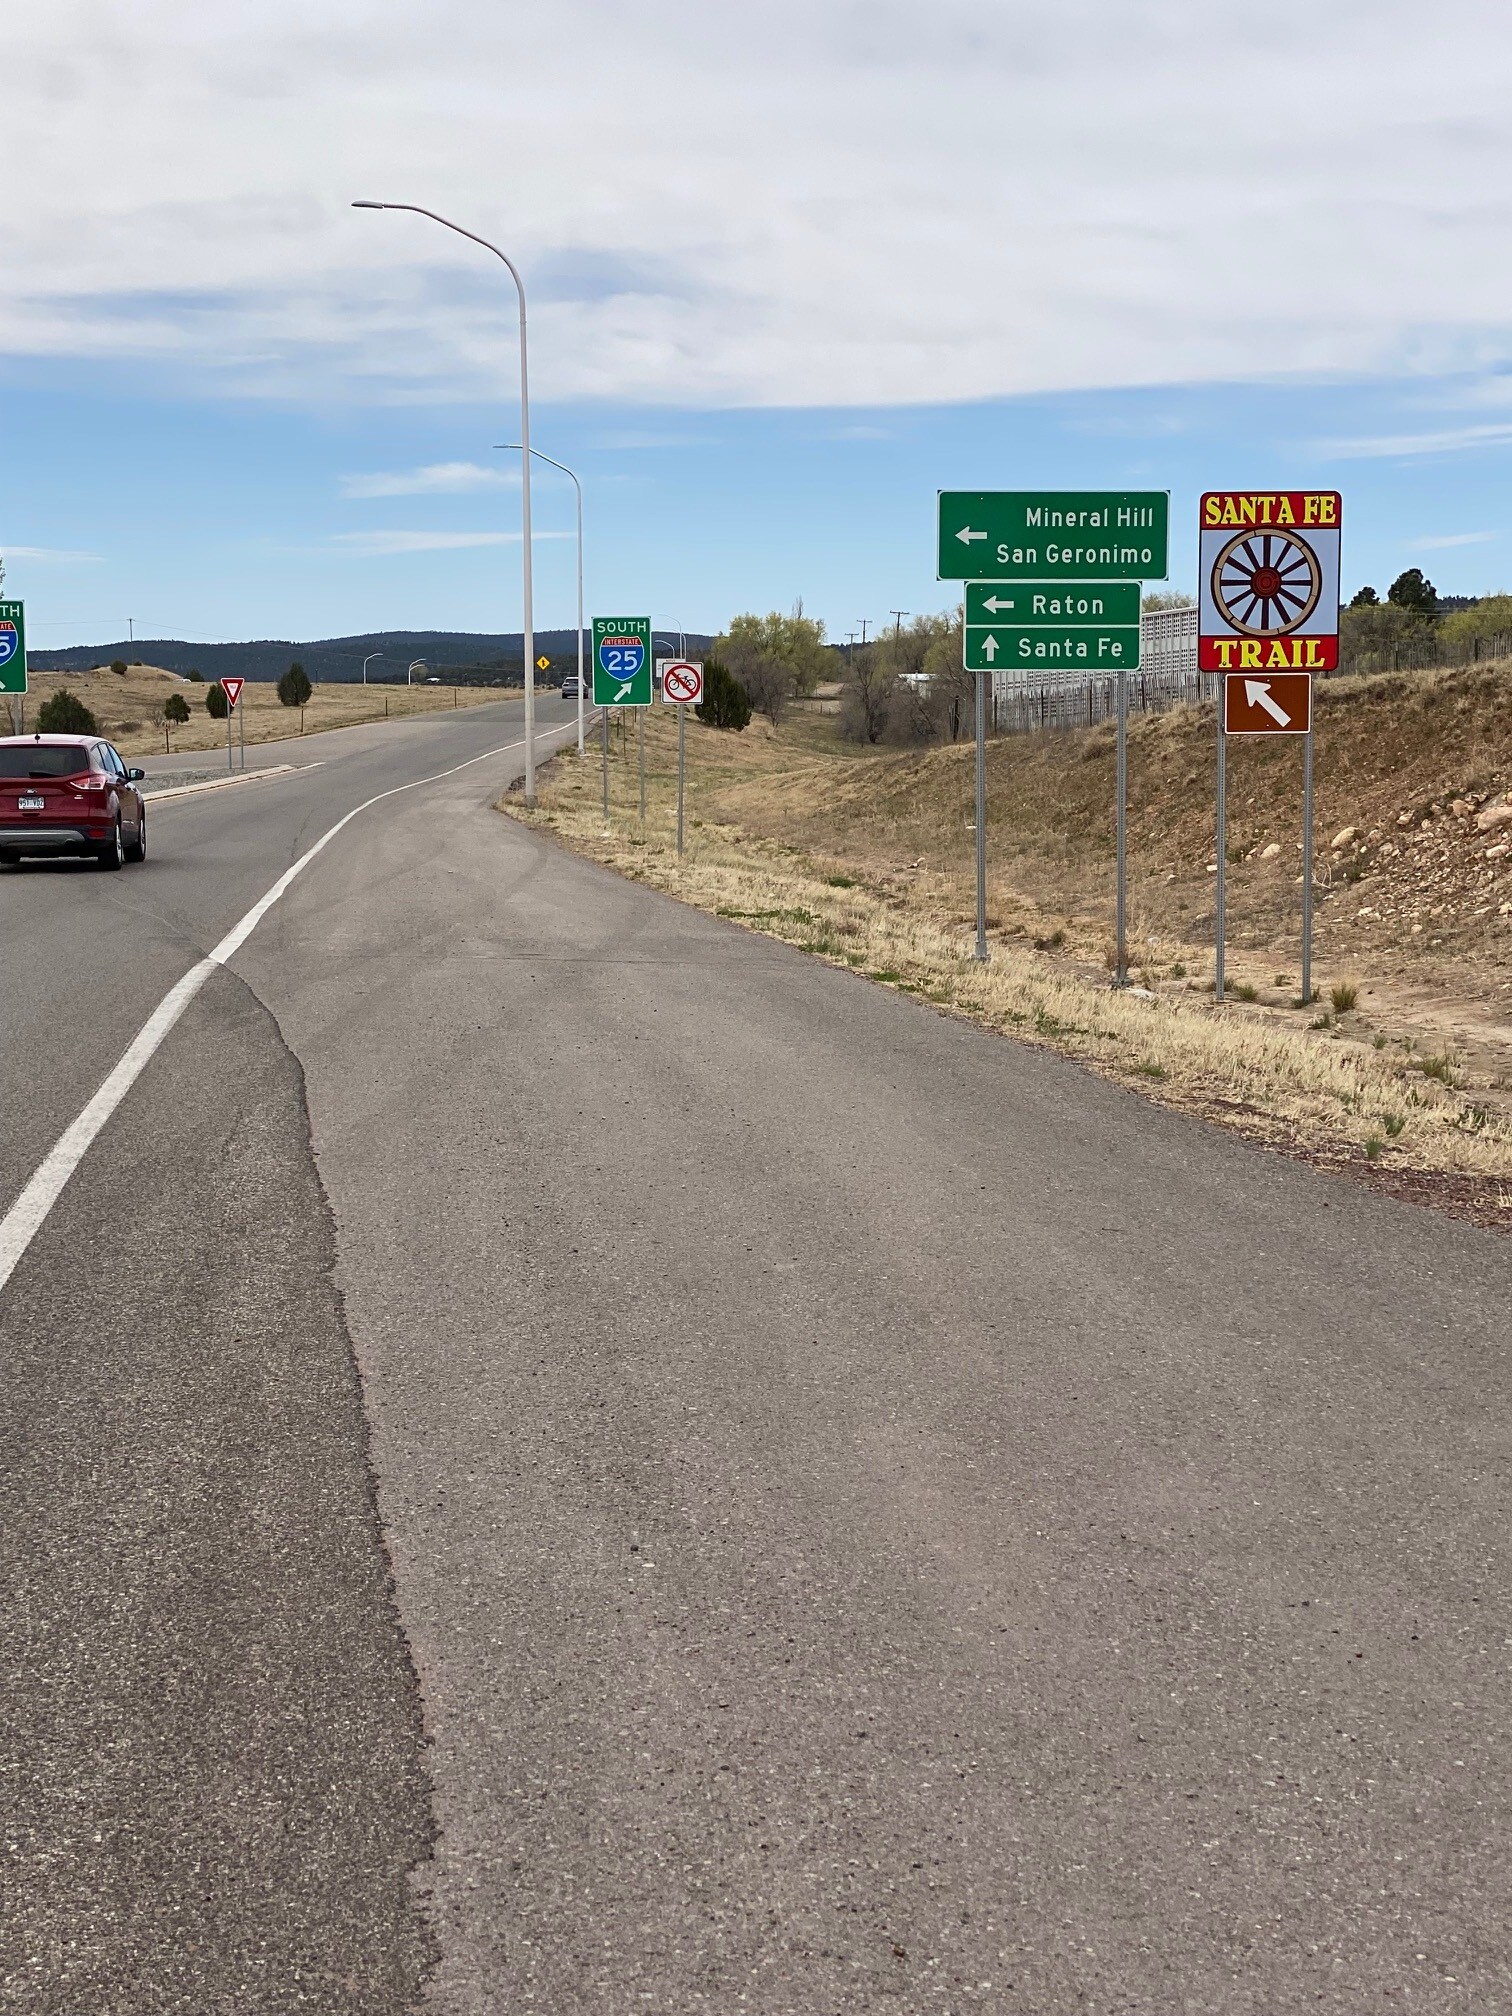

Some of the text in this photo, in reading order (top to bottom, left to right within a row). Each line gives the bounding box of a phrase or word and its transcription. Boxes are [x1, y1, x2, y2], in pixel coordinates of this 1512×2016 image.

[1026, 507, 1153, 527] Mineral Hill
[1205, 496, 1336, 524] SANTA FE
[997, 544, 1152, 563] San Geronimo
[1032, 595, 1104, 615] Raton
[597, 622, 646, 632] SOUTH
[1018, 638, 1123, 657] Santa Fe
[1213, 640, 1325, 668] TRAIL
[608, 651, 638, 670] 25
